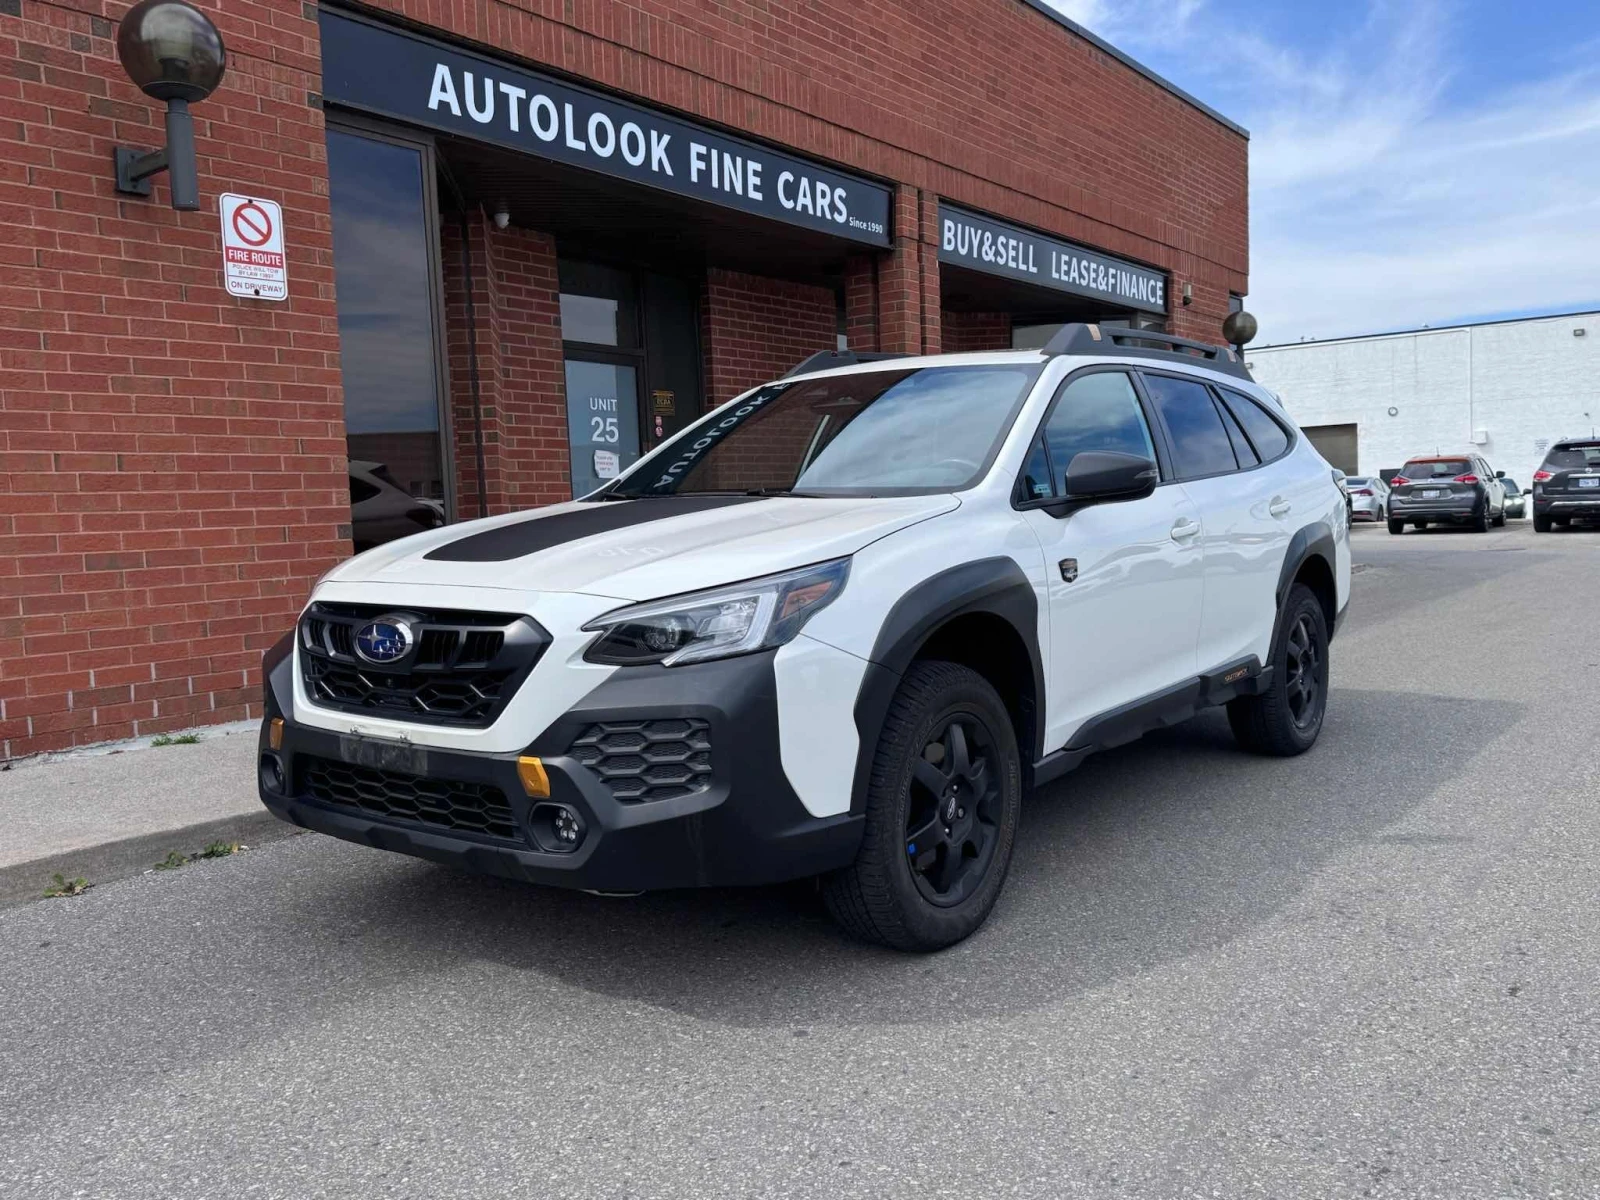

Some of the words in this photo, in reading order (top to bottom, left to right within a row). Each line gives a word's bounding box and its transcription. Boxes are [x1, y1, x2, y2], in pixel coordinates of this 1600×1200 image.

[428, 63, 673, 176] AUTOLOOK
[690, 142, 763, 201] FINE
[777, 171, 848, 223] CARS
[849, 216, 867, 230] Since
[868, 221, 883, 234] 1990
[228, 249, 250, 262] FIRE
[251, 252, 282, 266] ROUTE
[943, 219, 1038, 274] BUY&SELL
[1051, 251, 1164, 305] LEASE&FINANCE
[232, 263, 252, 271] POLICE
[231, 281, 243, 289] ON
[244, 282, 283, 293] DRIVEWAY
[589, 397, 618, 412] UNIT
[590, 416, 619, 443] 25
